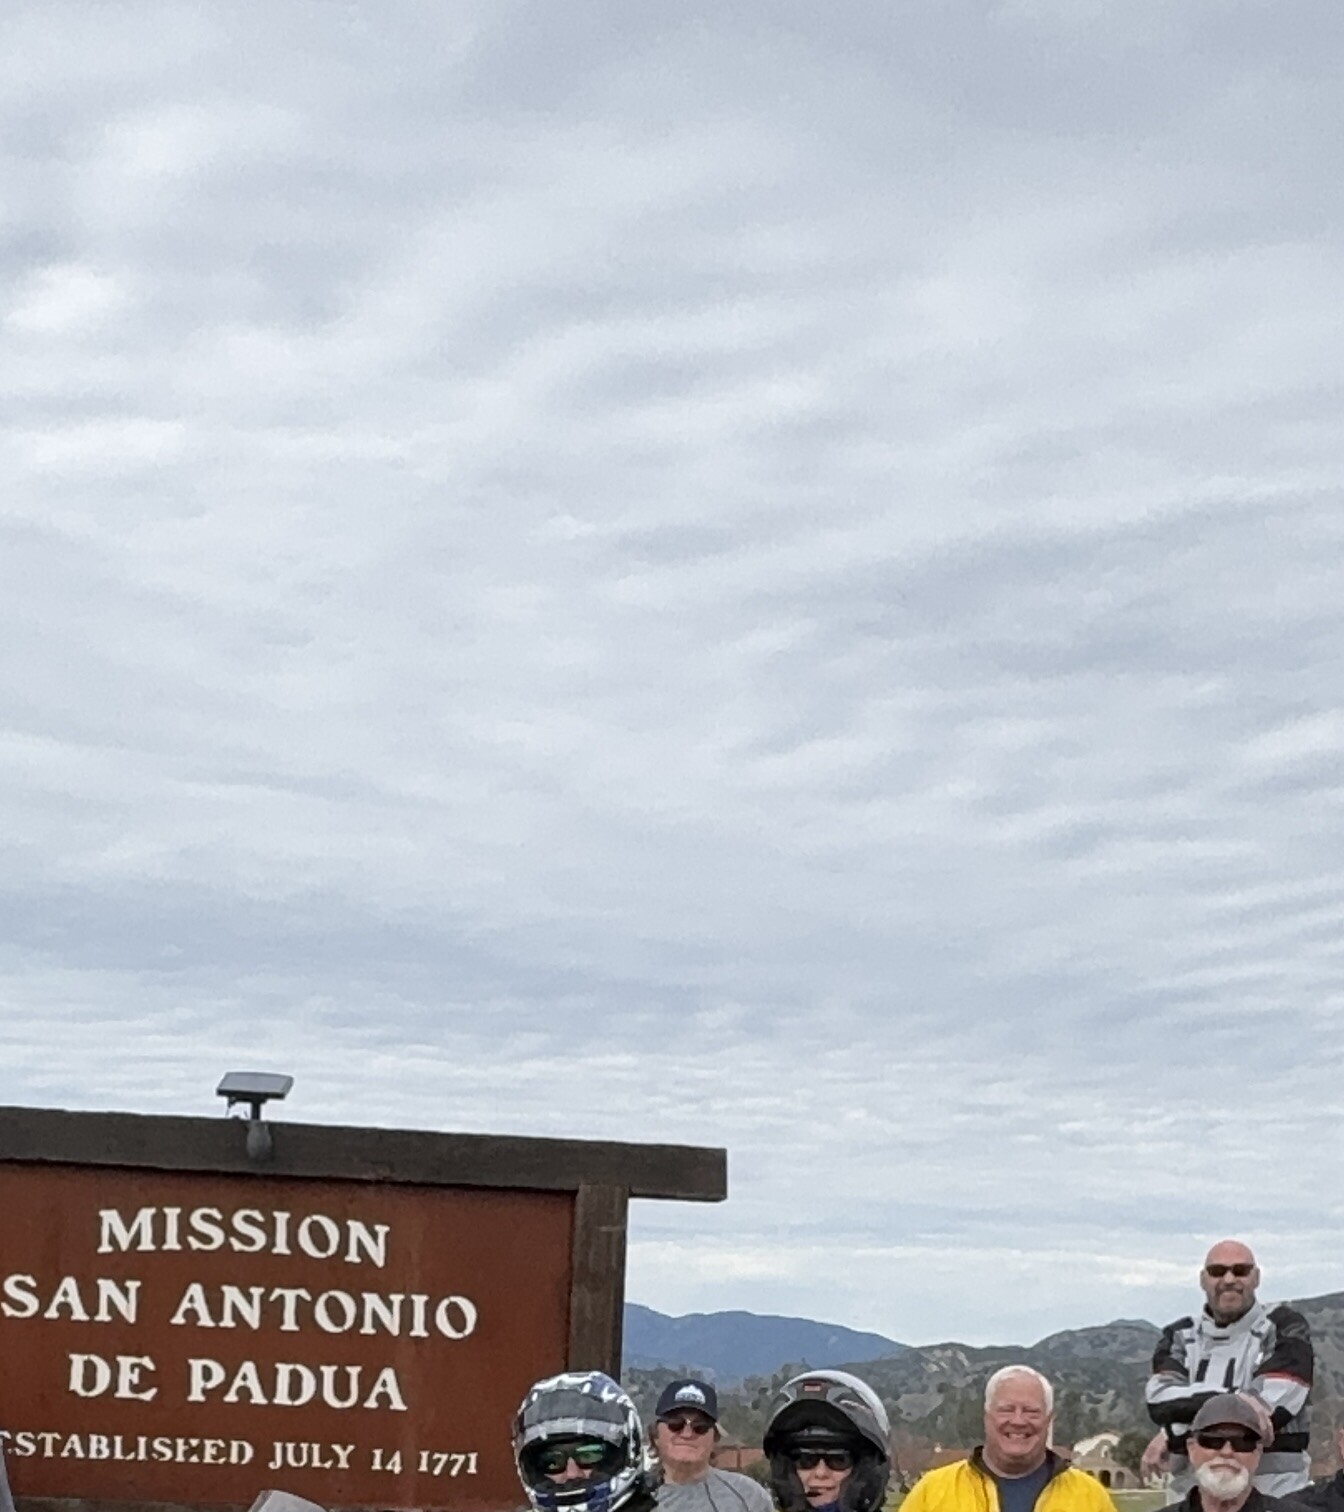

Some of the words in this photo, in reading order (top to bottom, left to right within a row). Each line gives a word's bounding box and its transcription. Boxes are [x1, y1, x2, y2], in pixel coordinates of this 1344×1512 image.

[97, 1207, 391, 1268] MISSION
[0, 1273, 142, 1324] SAN
[170, 1282, 478, 1340] ANTONIO
[68, 1353, 158, 1401] DE
[187, 1357, 408, 1411] PADUA
[268, 1441, 356, 1471] JULY
[371, 1448, 403, 1475] 14
[418, 1449, 480, 1477] 1771
